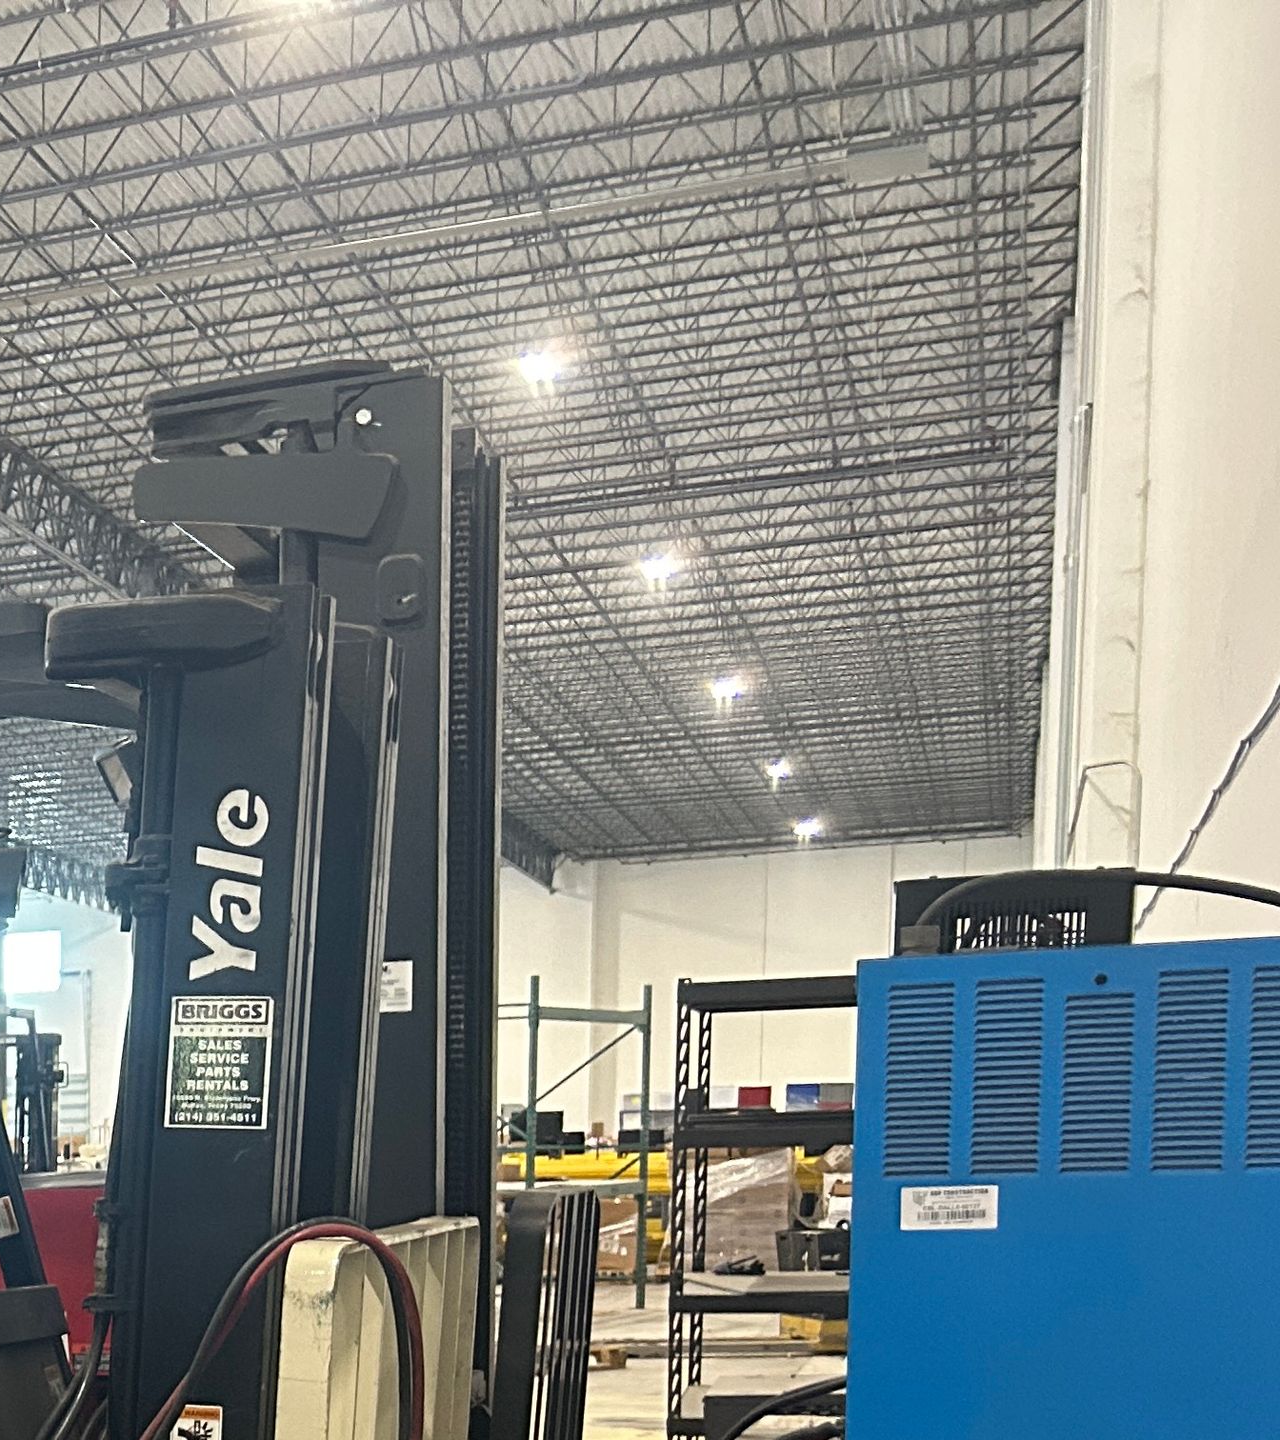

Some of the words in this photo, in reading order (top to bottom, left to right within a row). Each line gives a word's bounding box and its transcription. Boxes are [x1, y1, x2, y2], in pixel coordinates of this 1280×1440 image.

[188, 788, 270, 982] Yale
[181, 1004, 263, 1019] BRIGGS
[198, 1039, 242, 1051] SALES
[189, 1052, 250, 1064] SERVICE
[195, 1066, 241, 1078] PARTS
[186, 1079, 249, 1091] RENTALS
